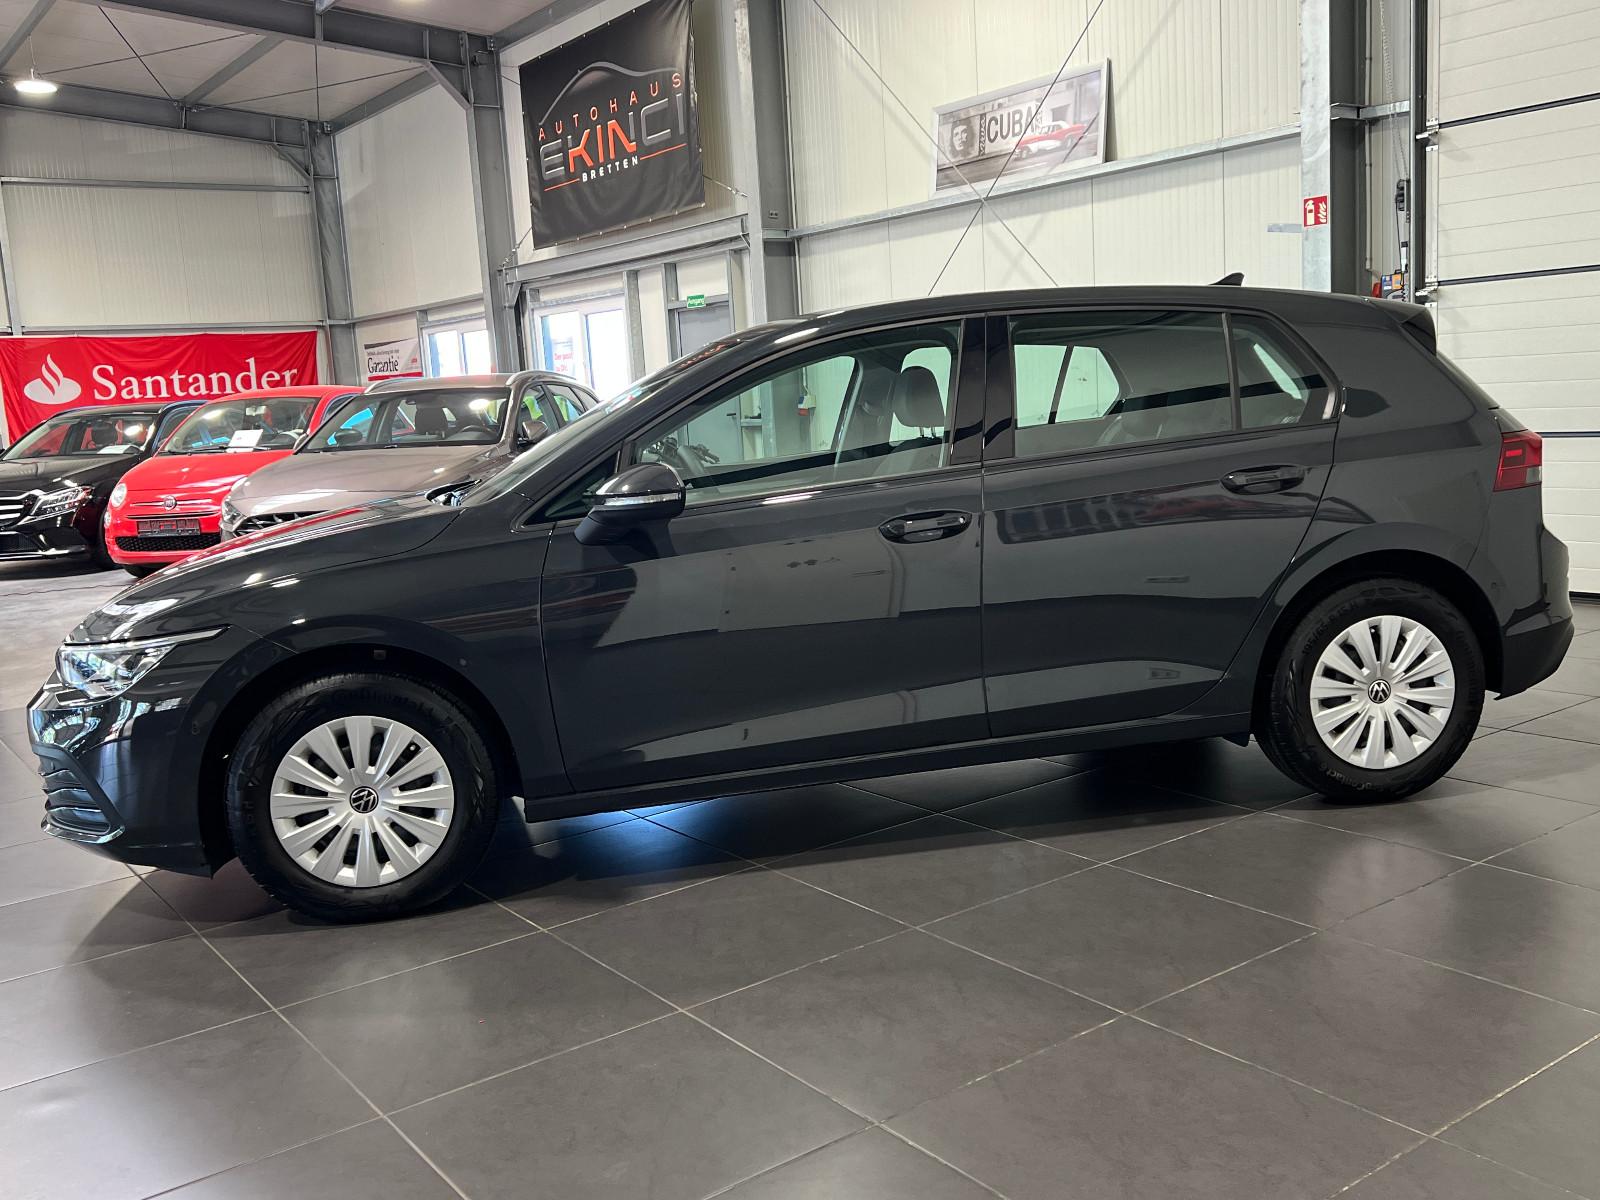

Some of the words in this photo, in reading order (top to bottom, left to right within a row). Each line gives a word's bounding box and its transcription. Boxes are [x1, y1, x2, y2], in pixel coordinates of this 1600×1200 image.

[538, 72, 682, 141] AUTOHAUS
[987, 105, 1035, 143] CUBA
[582, 156, 639, 182] BRETTEN
[93, 357, 298, 400] Santander
[367, 357, 400, 373] Garantie
